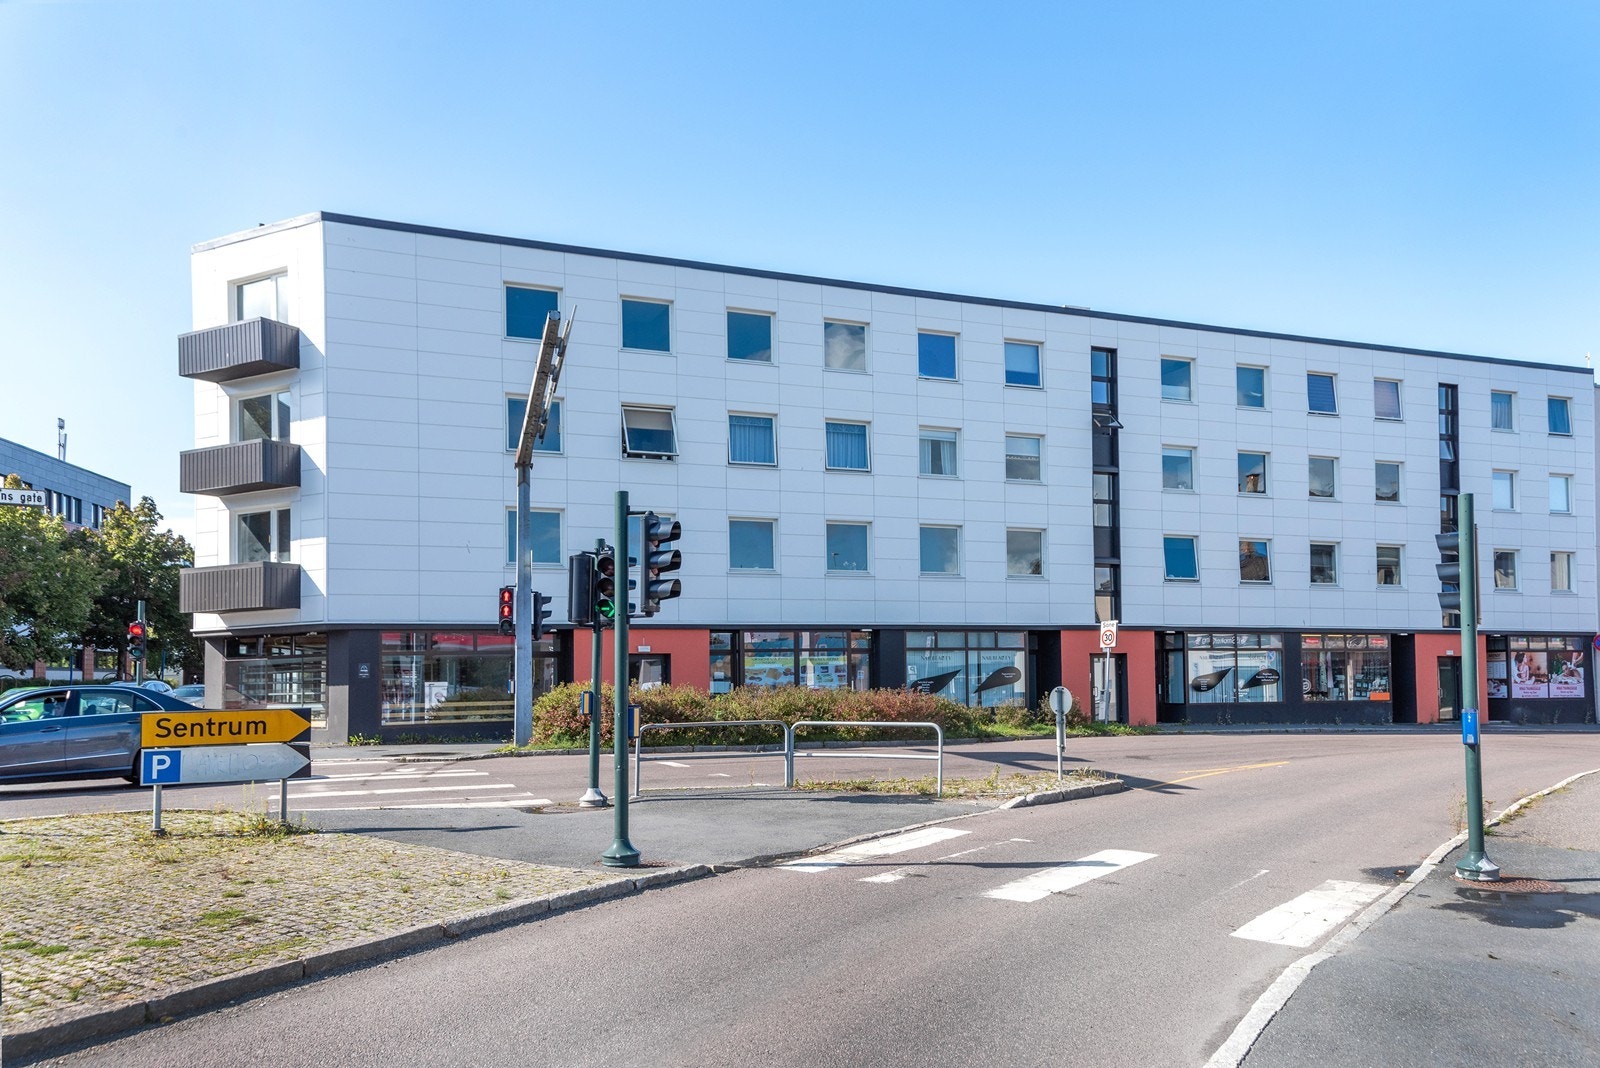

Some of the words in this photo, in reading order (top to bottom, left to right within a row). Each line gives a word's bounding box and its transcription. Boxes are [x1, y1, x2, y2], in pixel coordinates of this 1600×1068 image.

[20, 493, 42, 504] gate
[1104, 633, 1113, 642] 30
[155, 717, 267, 739] Sentrum
[151, 754, 171, 780] P
